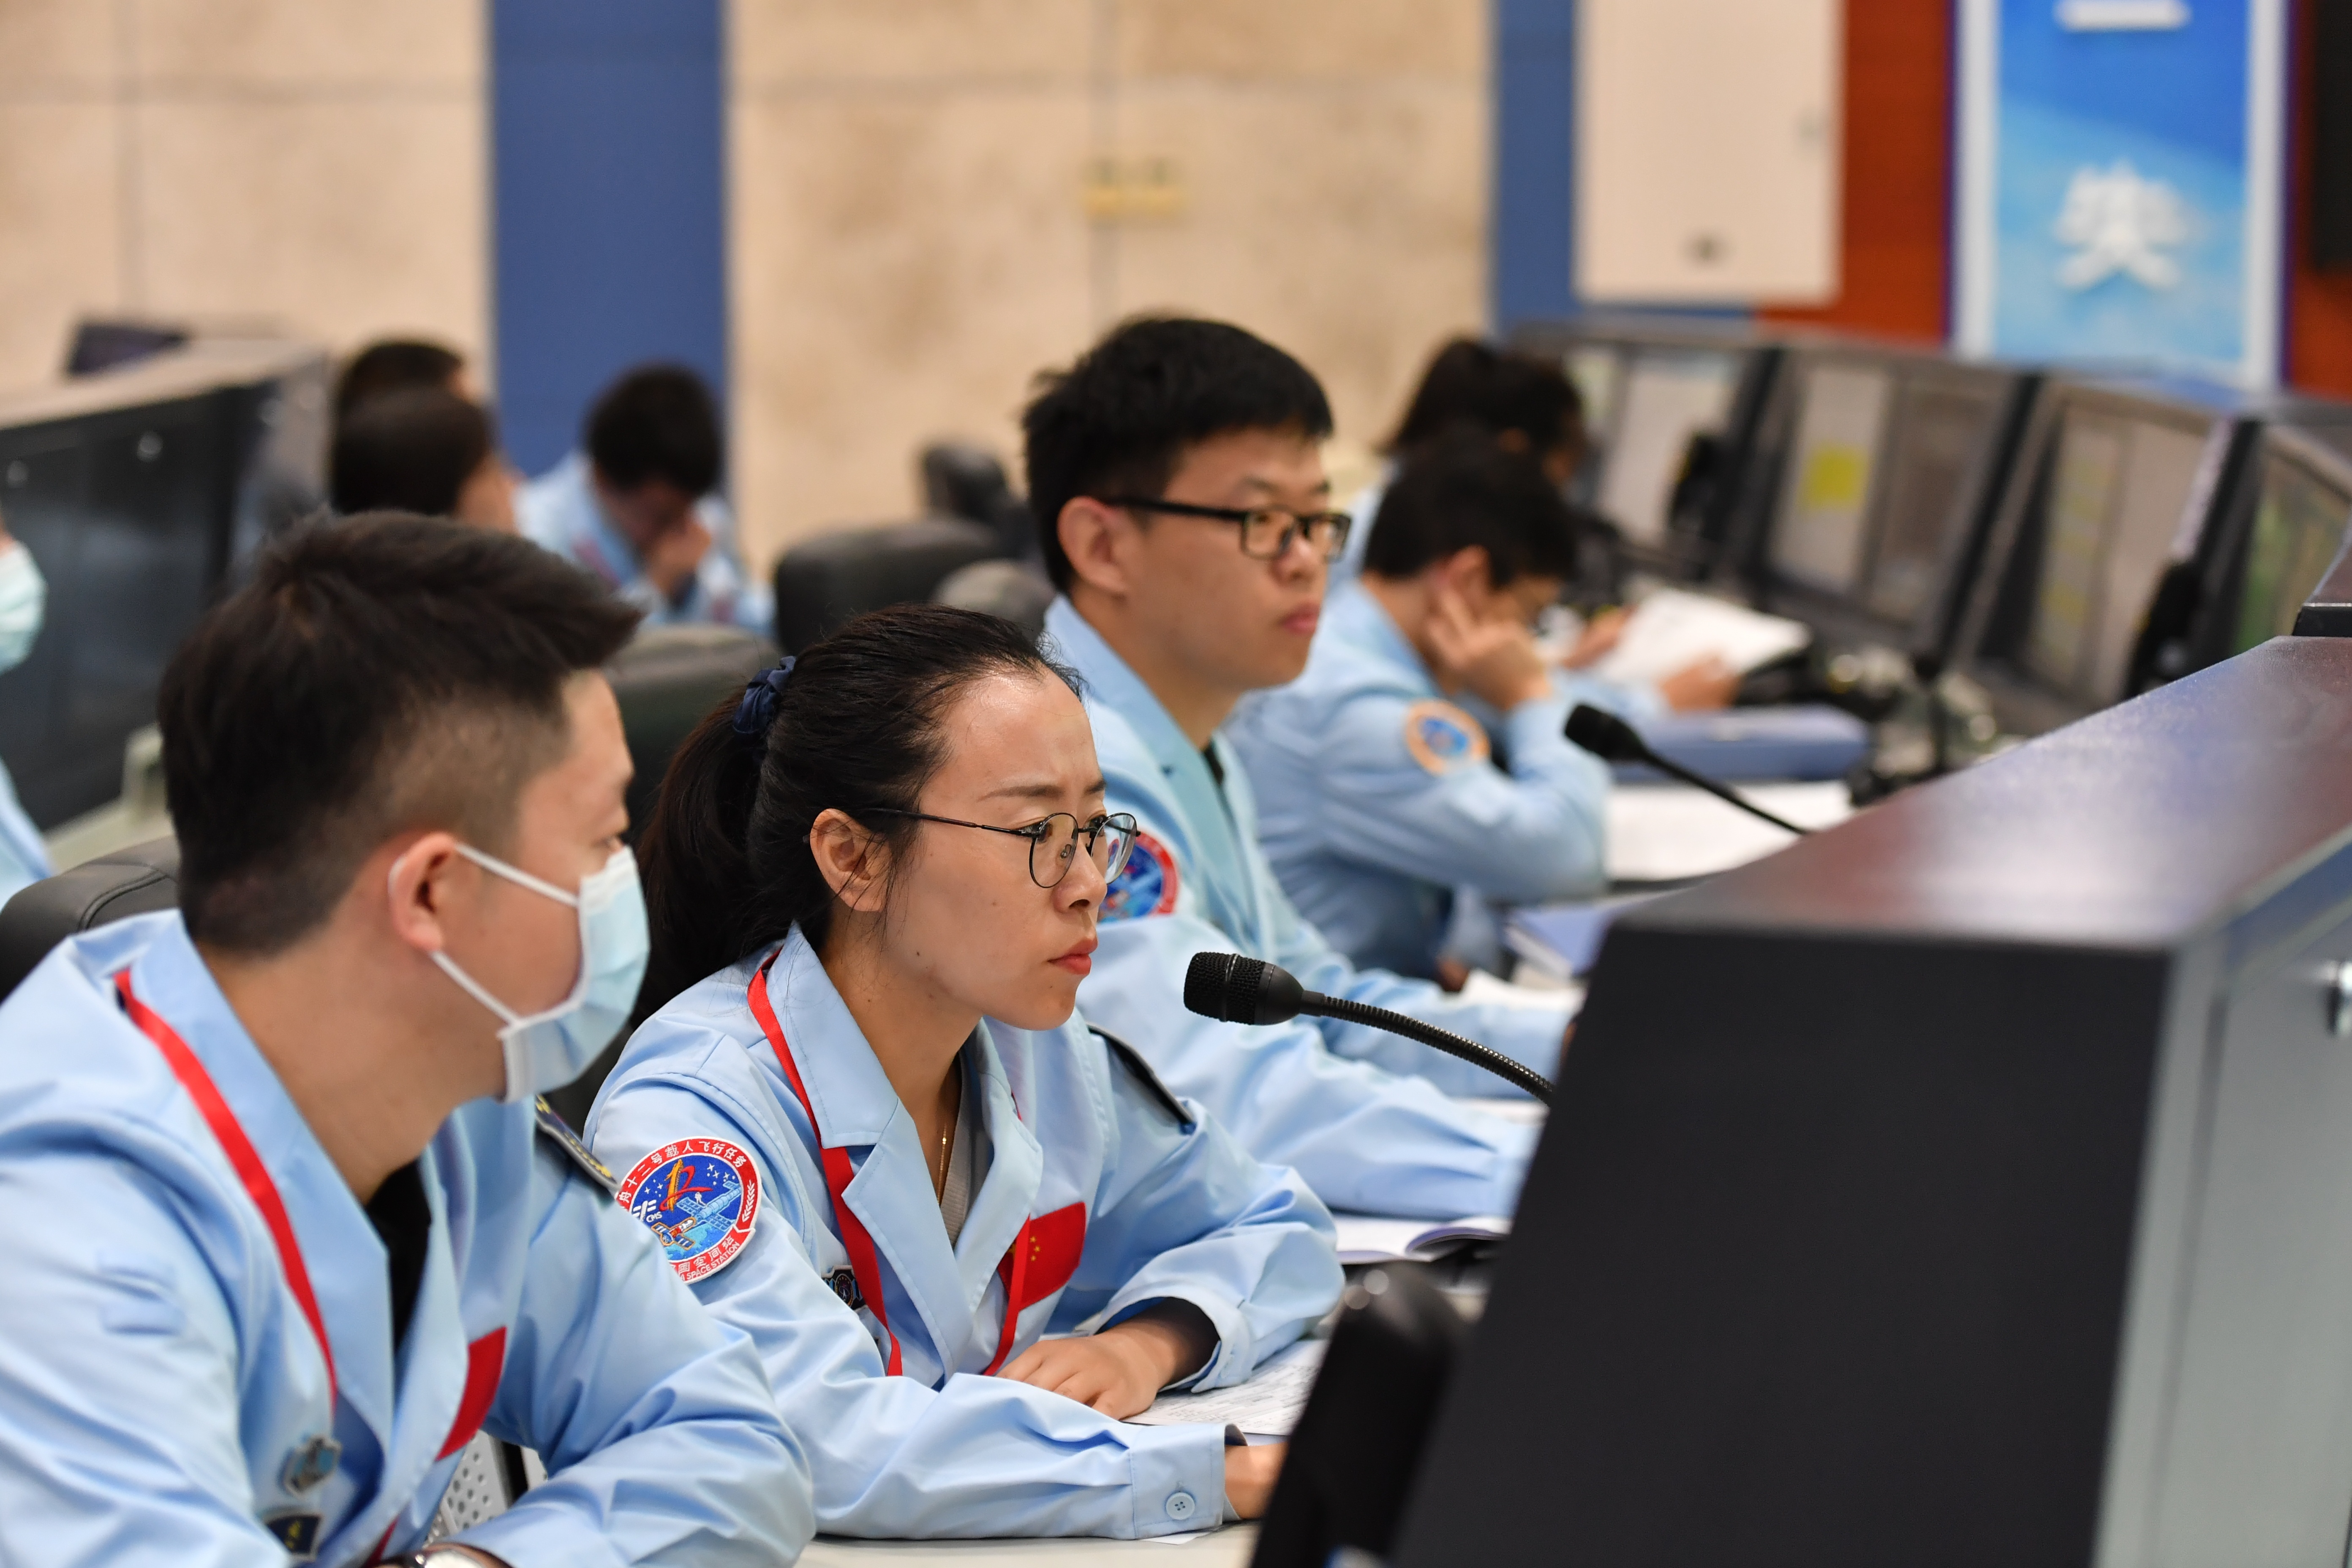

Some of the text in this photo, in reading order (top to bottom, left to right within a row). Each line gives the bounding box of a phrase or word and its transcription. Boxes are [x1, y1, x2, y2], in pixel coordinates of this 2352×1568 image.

[618, 1141, 747, 1210] 舟十二号载人飞行任务
[646, 1211, 662, 1222] CMS
[686, 1241, 740, 1279] SPACE STATION
